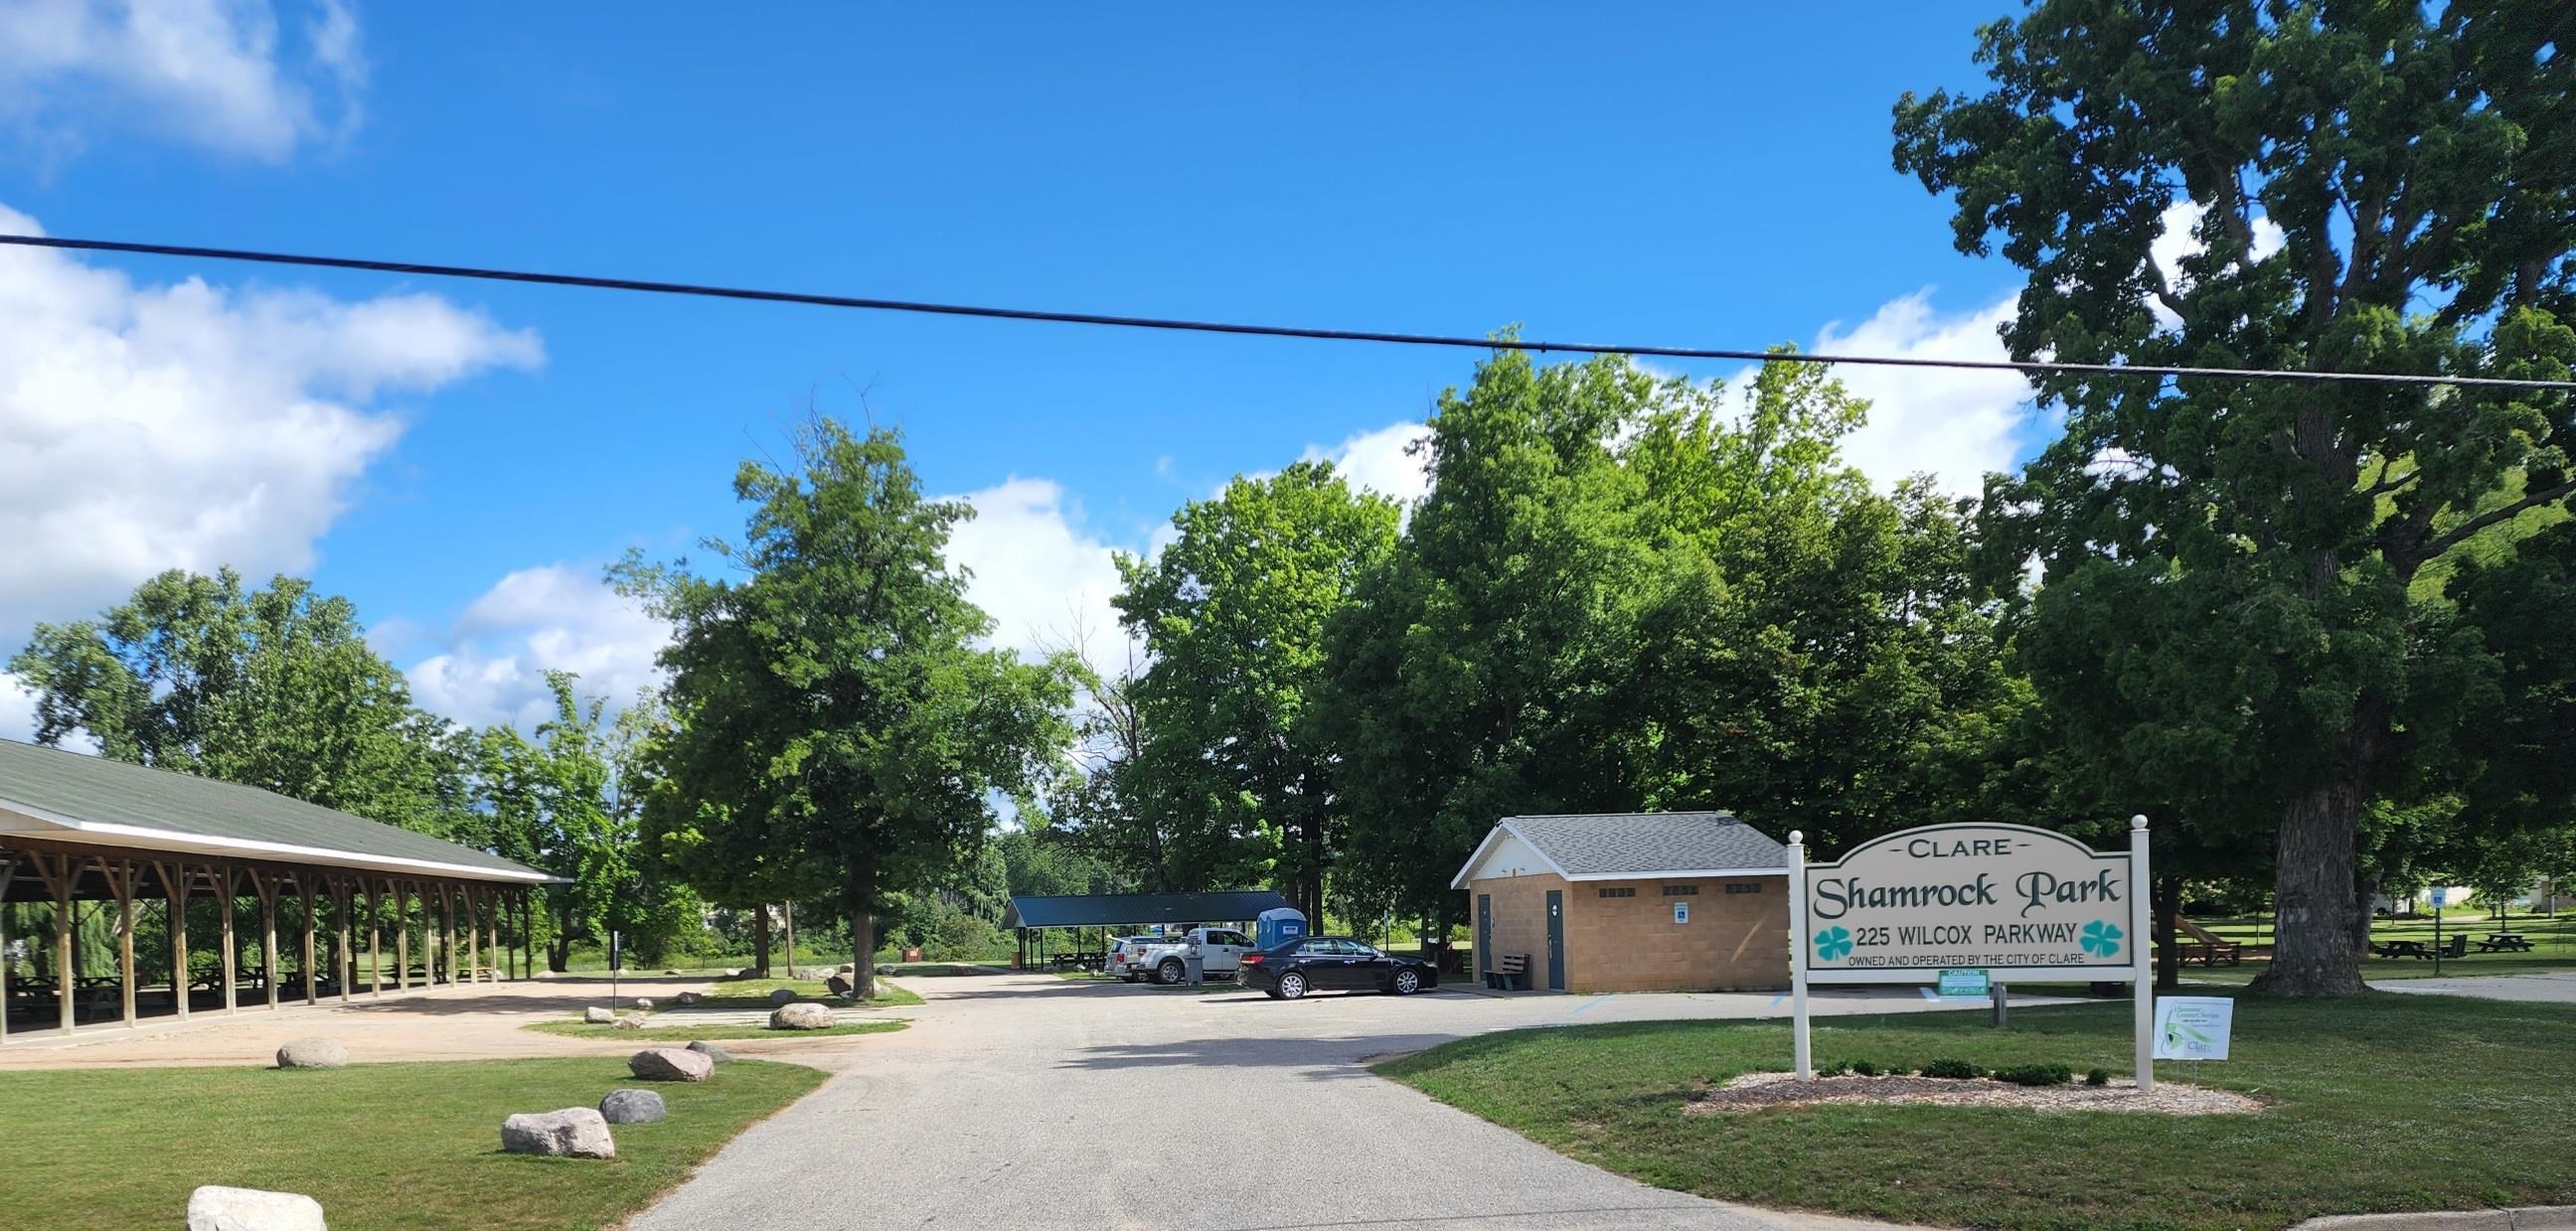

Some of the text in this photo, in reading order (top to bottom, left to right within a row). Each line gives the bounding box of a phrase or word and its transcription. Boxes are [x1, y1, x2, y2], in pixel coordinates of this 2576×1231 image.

[1814, 868, 2123, 920] Shamrock Park
[1855, 922, 2078, 947] 225 WILCOX PARKWAY
[1849, 953, 2085, 967] OWNED AND OPERATED BY THE CITY OF CLARE
